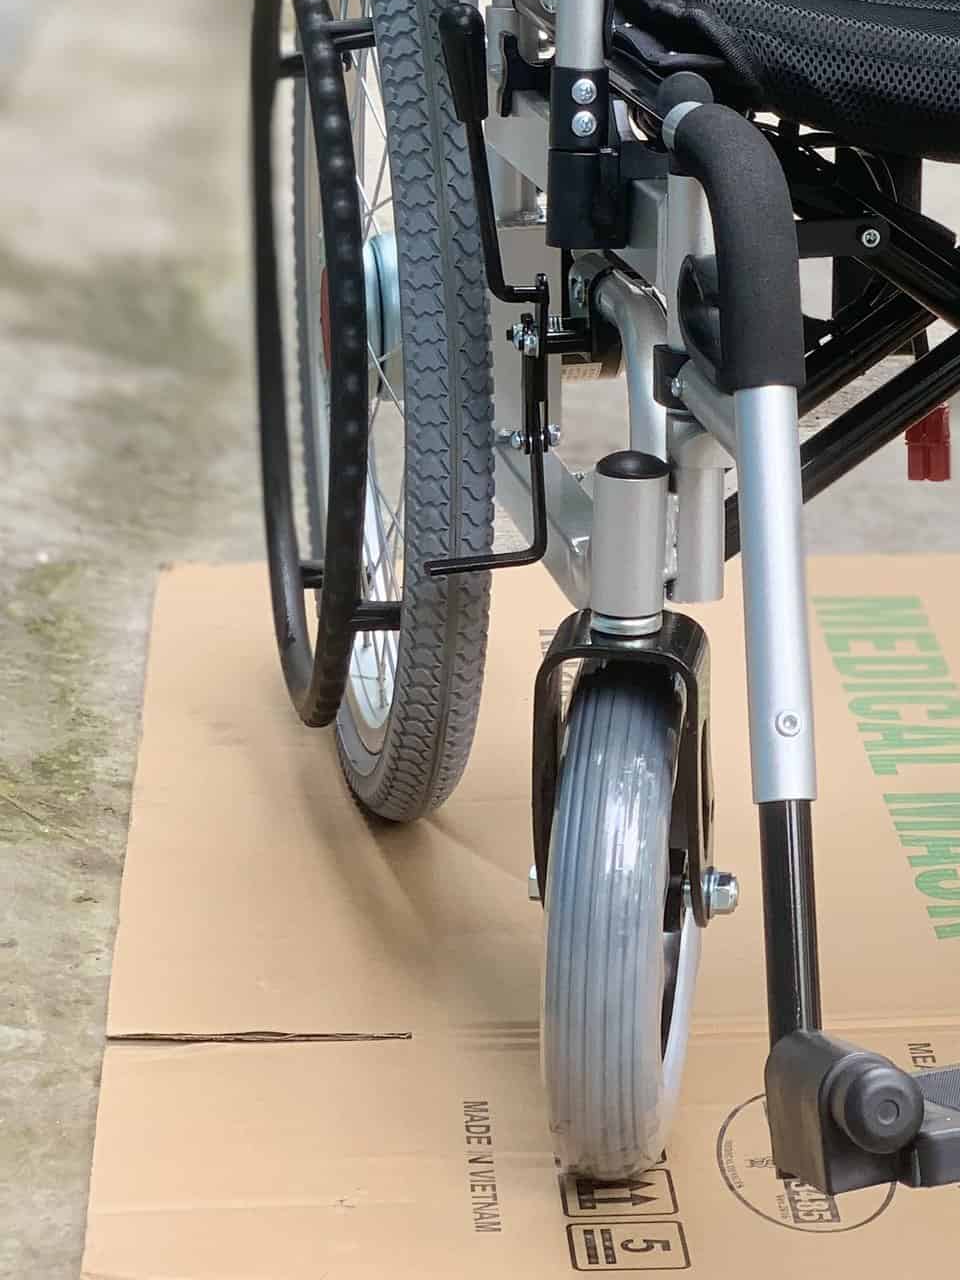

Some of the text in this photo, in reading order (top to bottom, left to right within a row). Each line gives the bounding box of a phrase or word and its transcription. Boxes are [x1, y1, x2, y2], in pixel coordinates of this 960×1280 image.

[464, 1101, 502, 1232] MADE IN VIETNAM
[620, 1239, 671, 1252] 5
